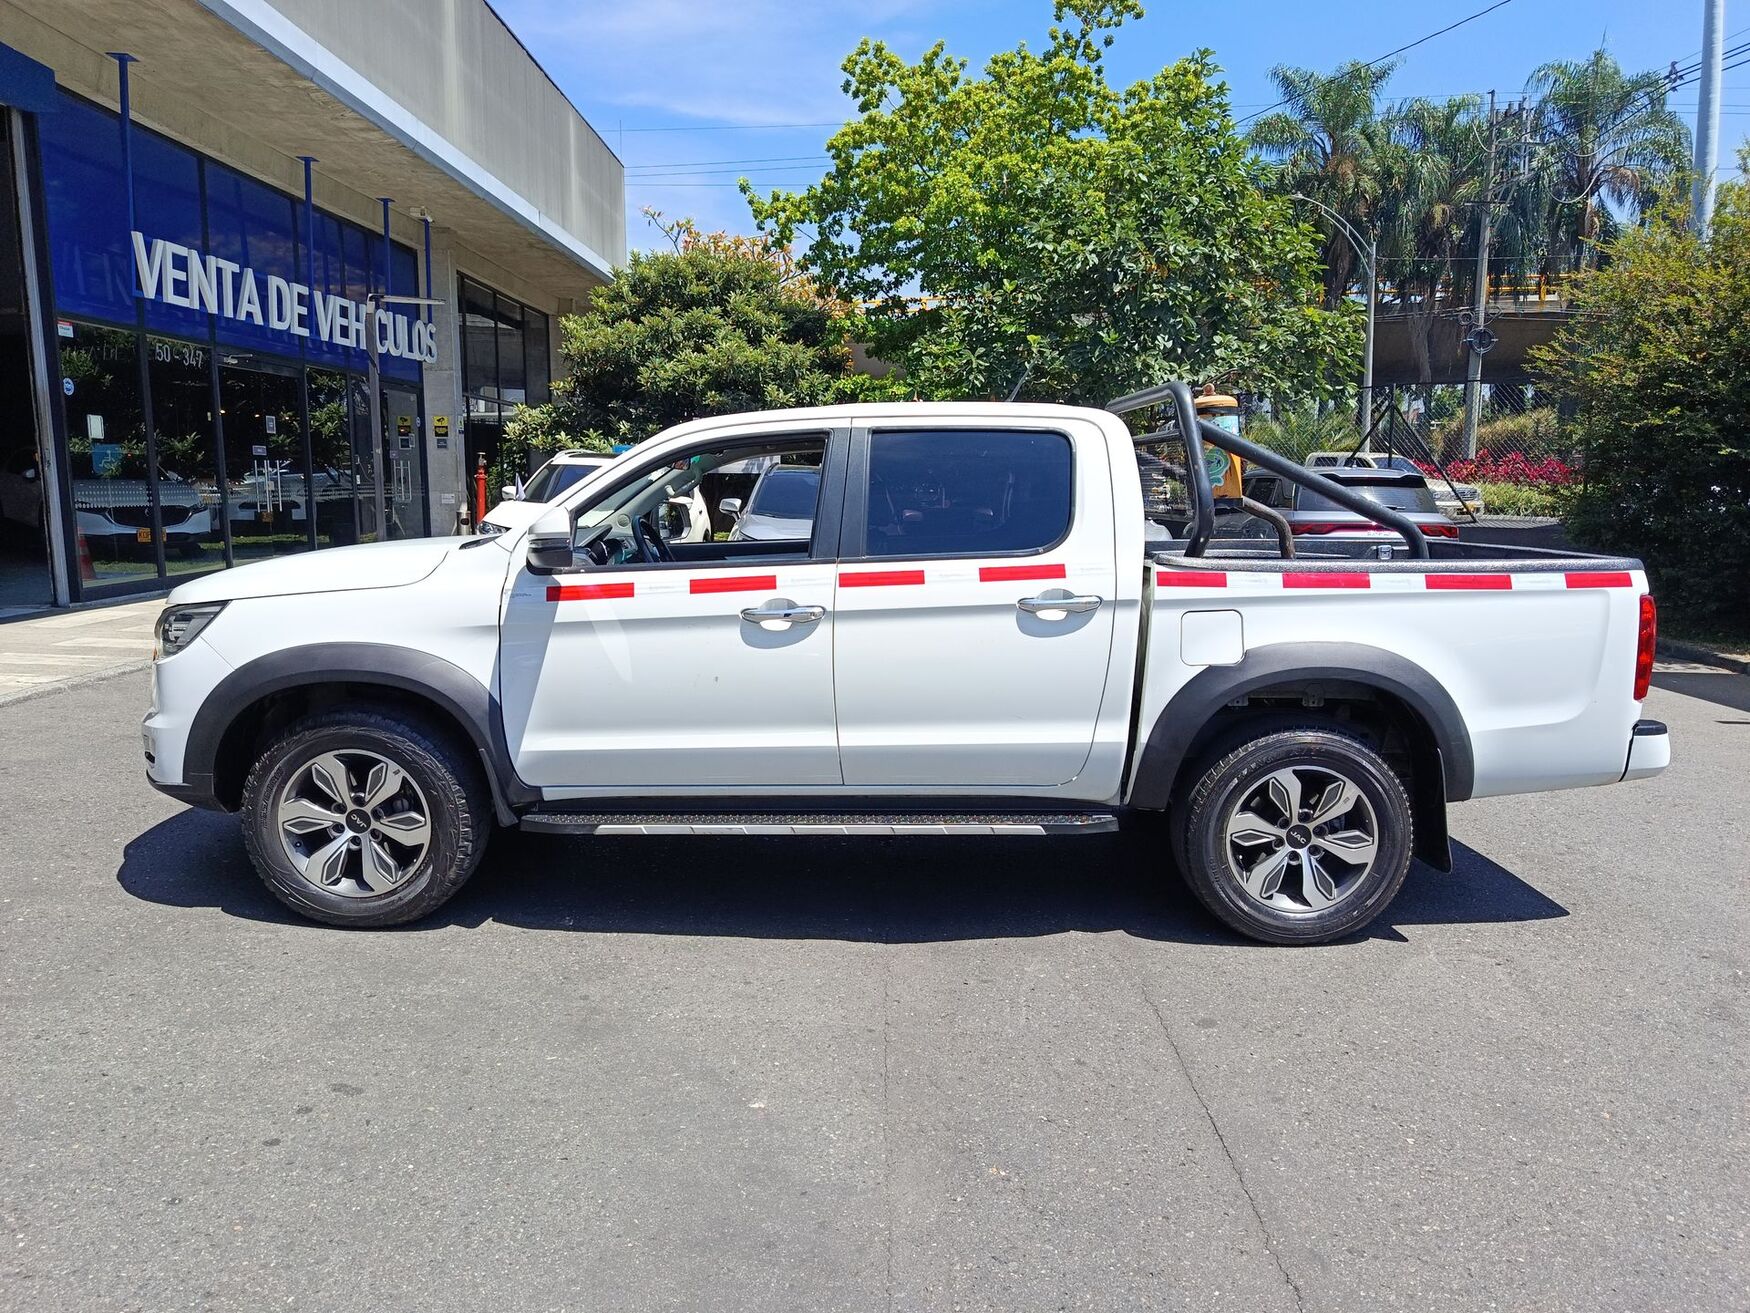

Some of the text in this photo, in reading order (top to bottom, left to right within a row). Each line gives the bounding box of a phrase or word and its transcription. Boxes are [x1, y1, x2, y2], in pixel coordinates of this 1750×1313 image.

[130, 231, 438, 364] VENTA DE VEHCULOS
[155, 343, 171, 363] 50
[182, 347, 203, 369] 347
[350, 813, 367, 828] JAC
[1290, 830, 1307, 845] JAC
